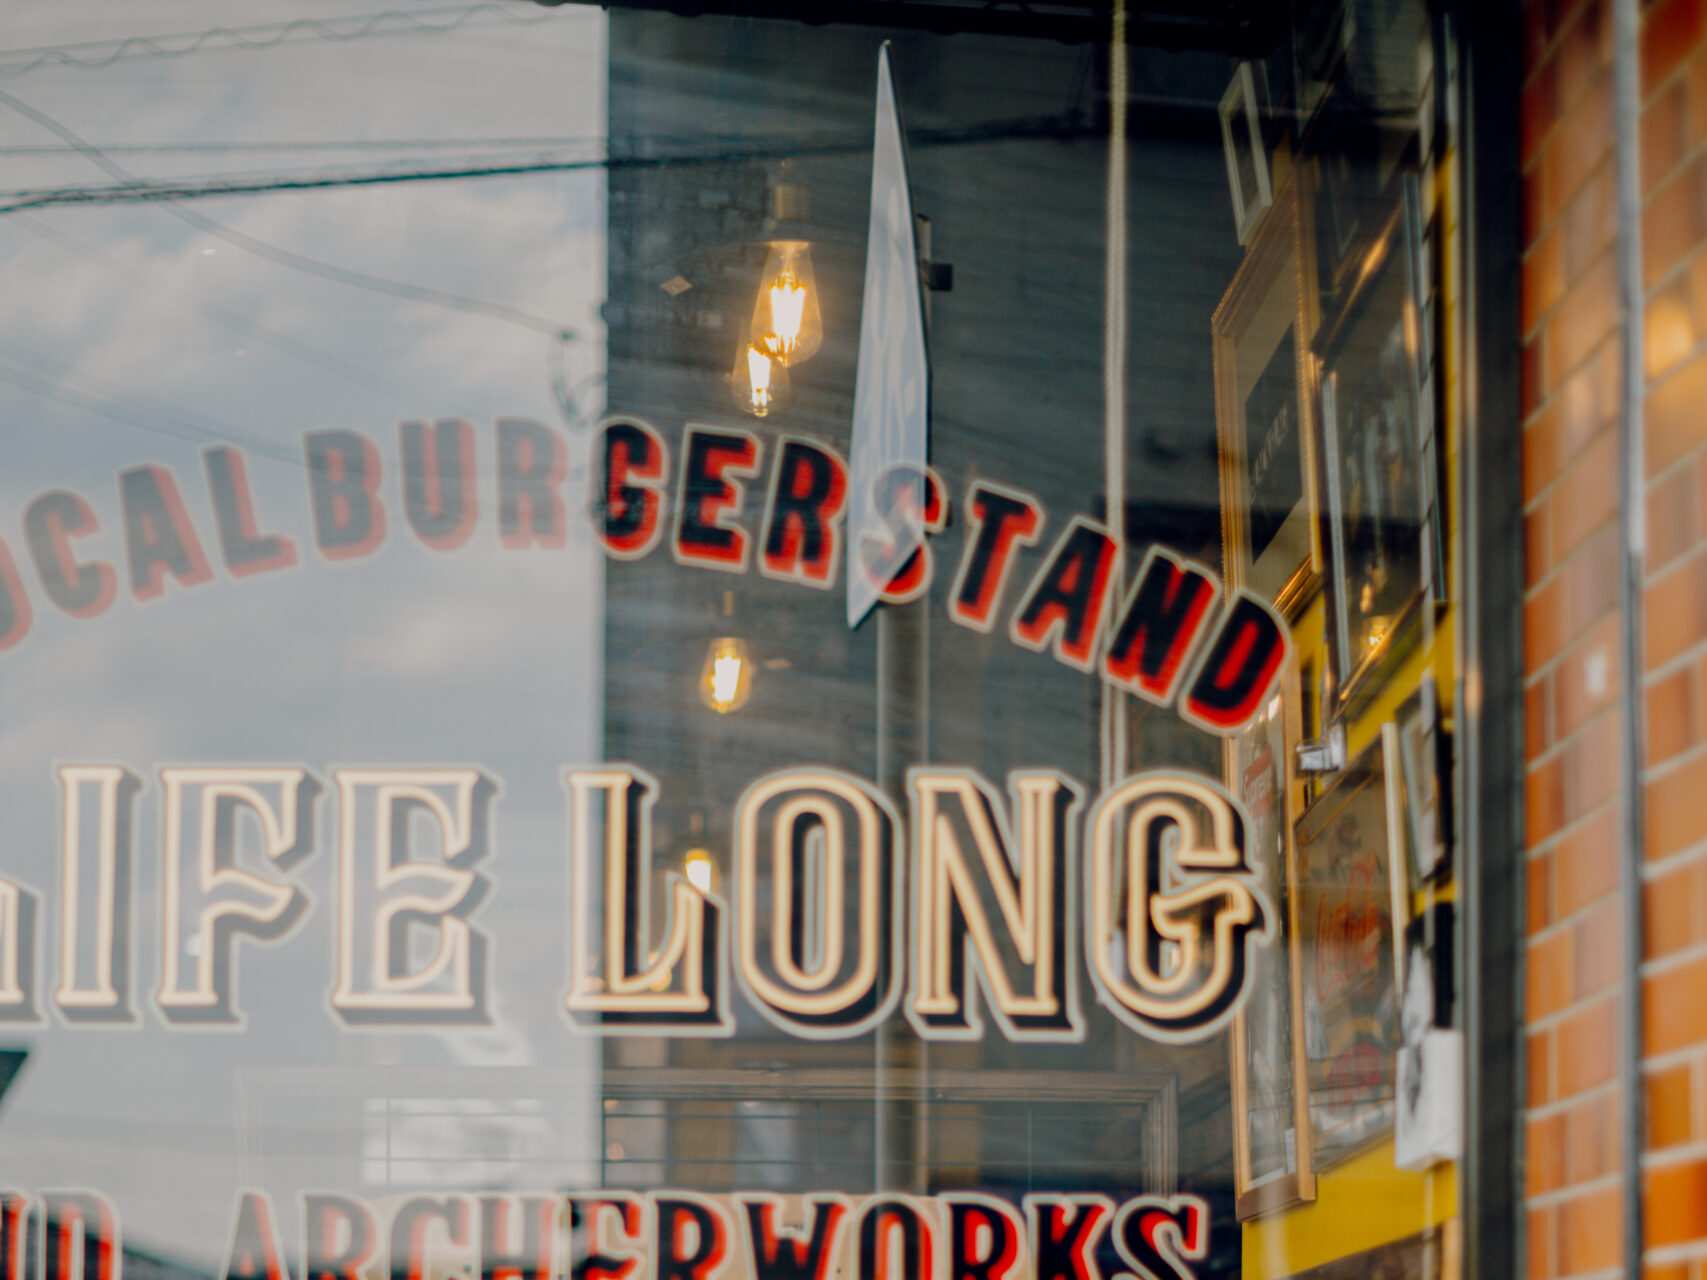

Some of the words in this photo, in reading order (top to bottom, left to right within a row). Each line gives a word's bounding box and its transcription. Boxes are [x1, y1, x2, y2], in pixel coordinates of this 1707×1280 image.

[298, 413, 851, 590] BURGER
[858, 460, 1292, 738] STAND
[558, 760, 1278, 1044] LONG
